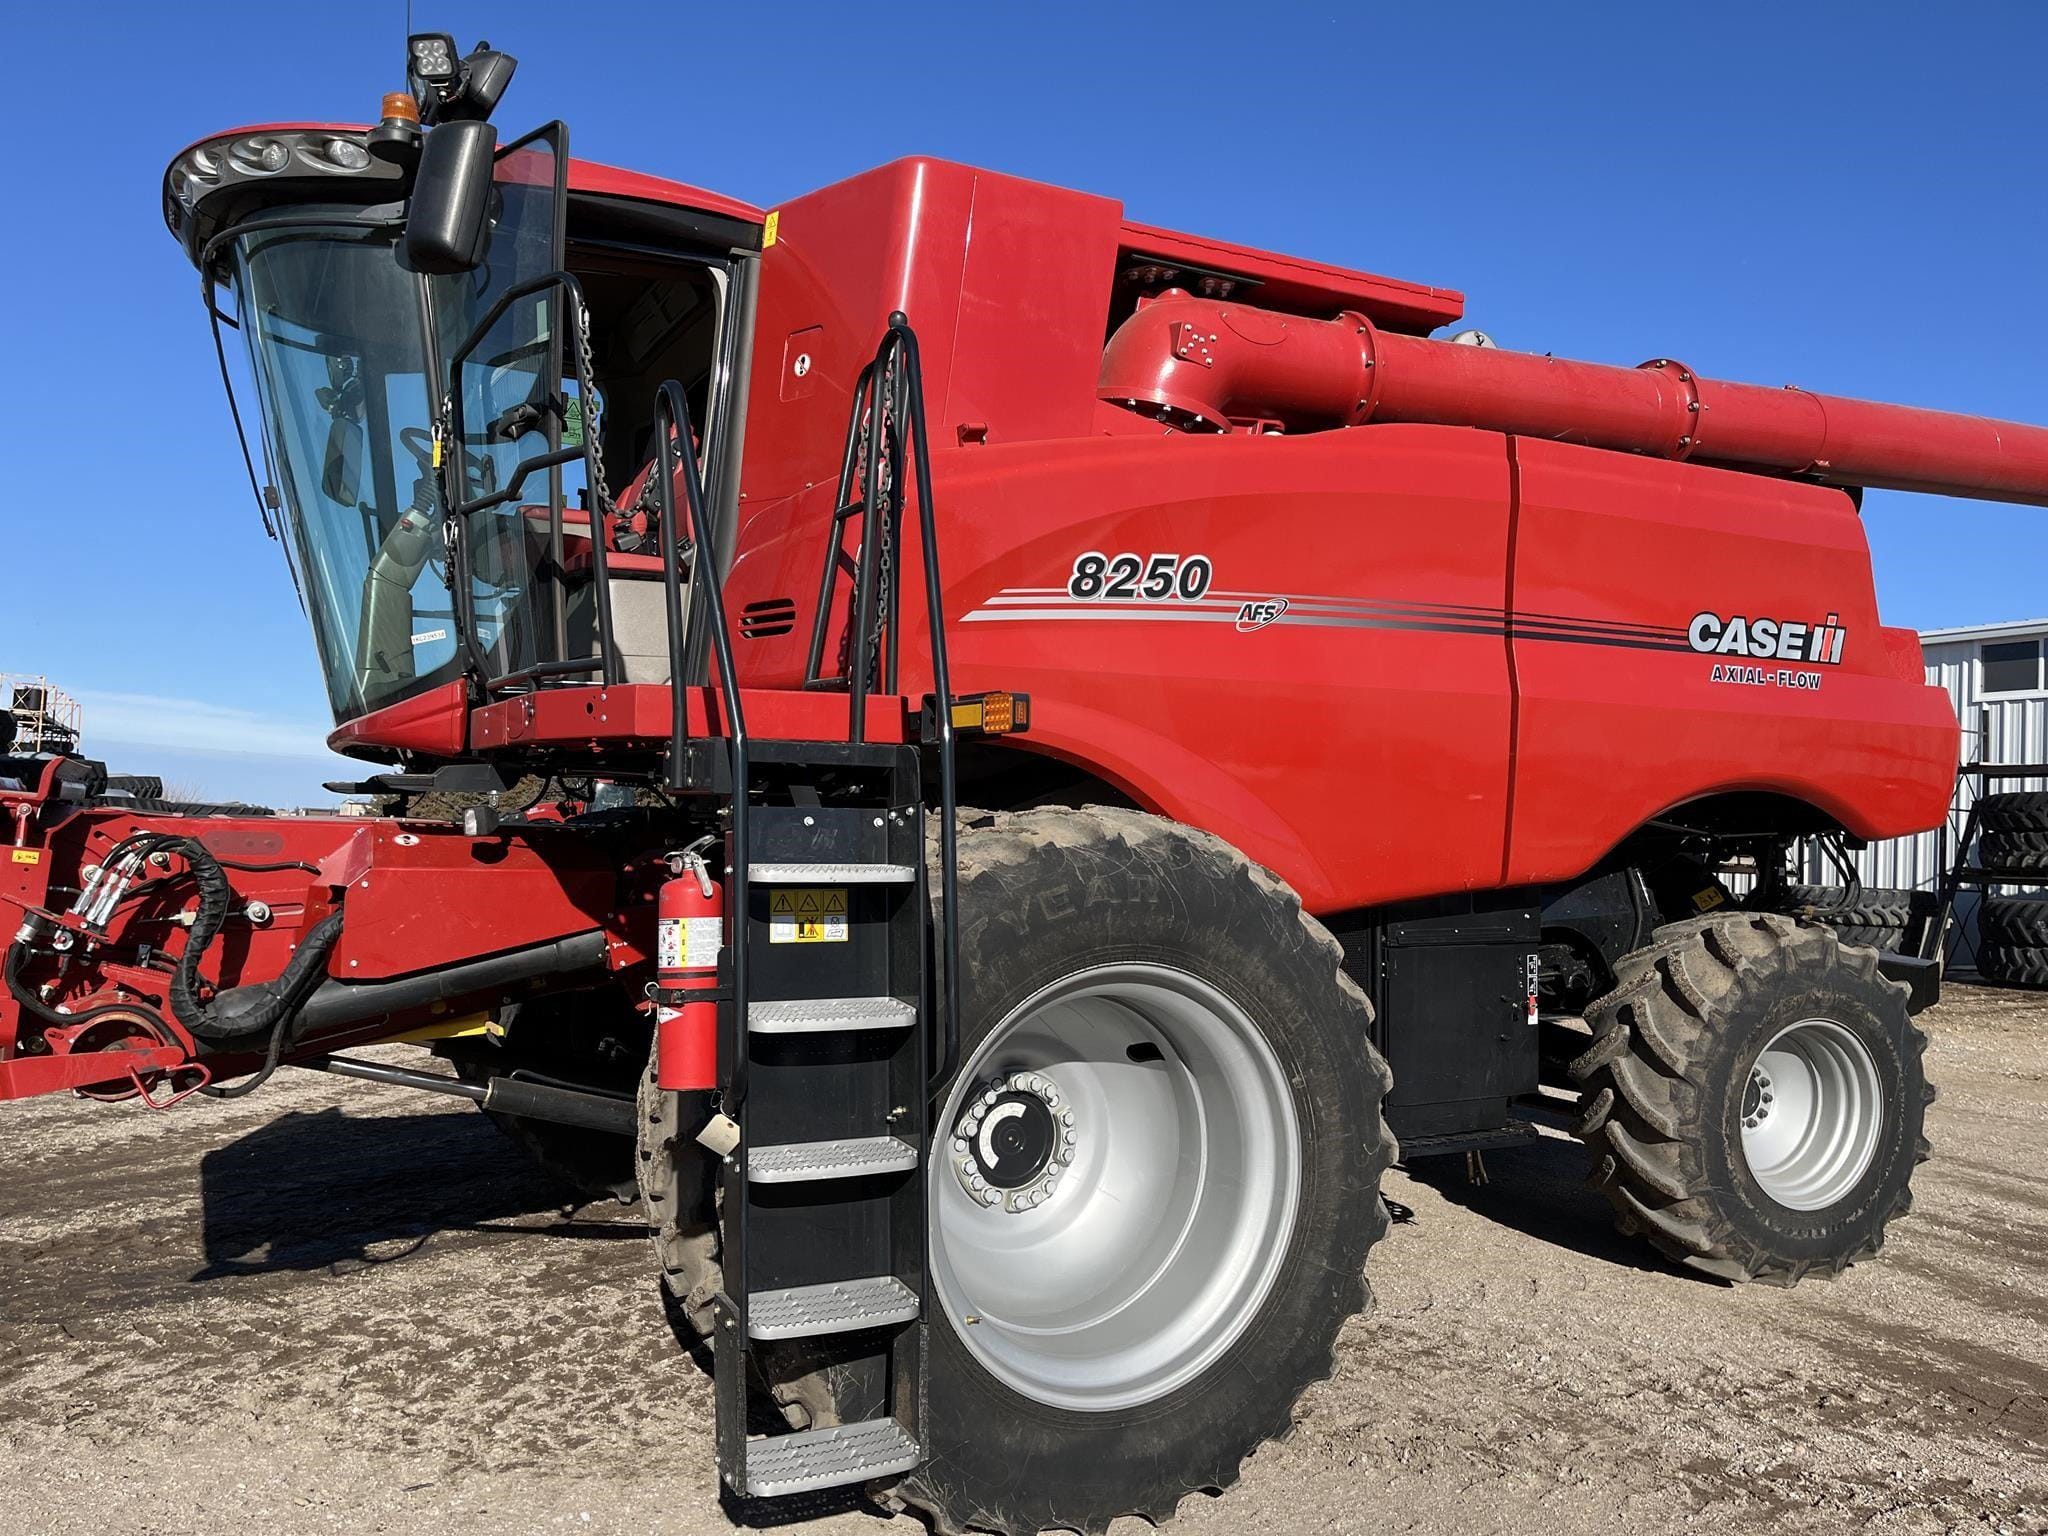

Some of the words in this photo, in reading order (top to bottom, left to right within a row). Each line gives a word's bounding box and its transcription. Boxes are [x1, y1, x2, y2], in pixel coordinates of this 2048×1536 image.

[1067, 551, 1212, 601] 8250
[1235, 601, 1277, 623] AFS
[1688, 611, 1807, 660] CASE
[1711, 664, 1822, 691] AXIAL-FLOW
